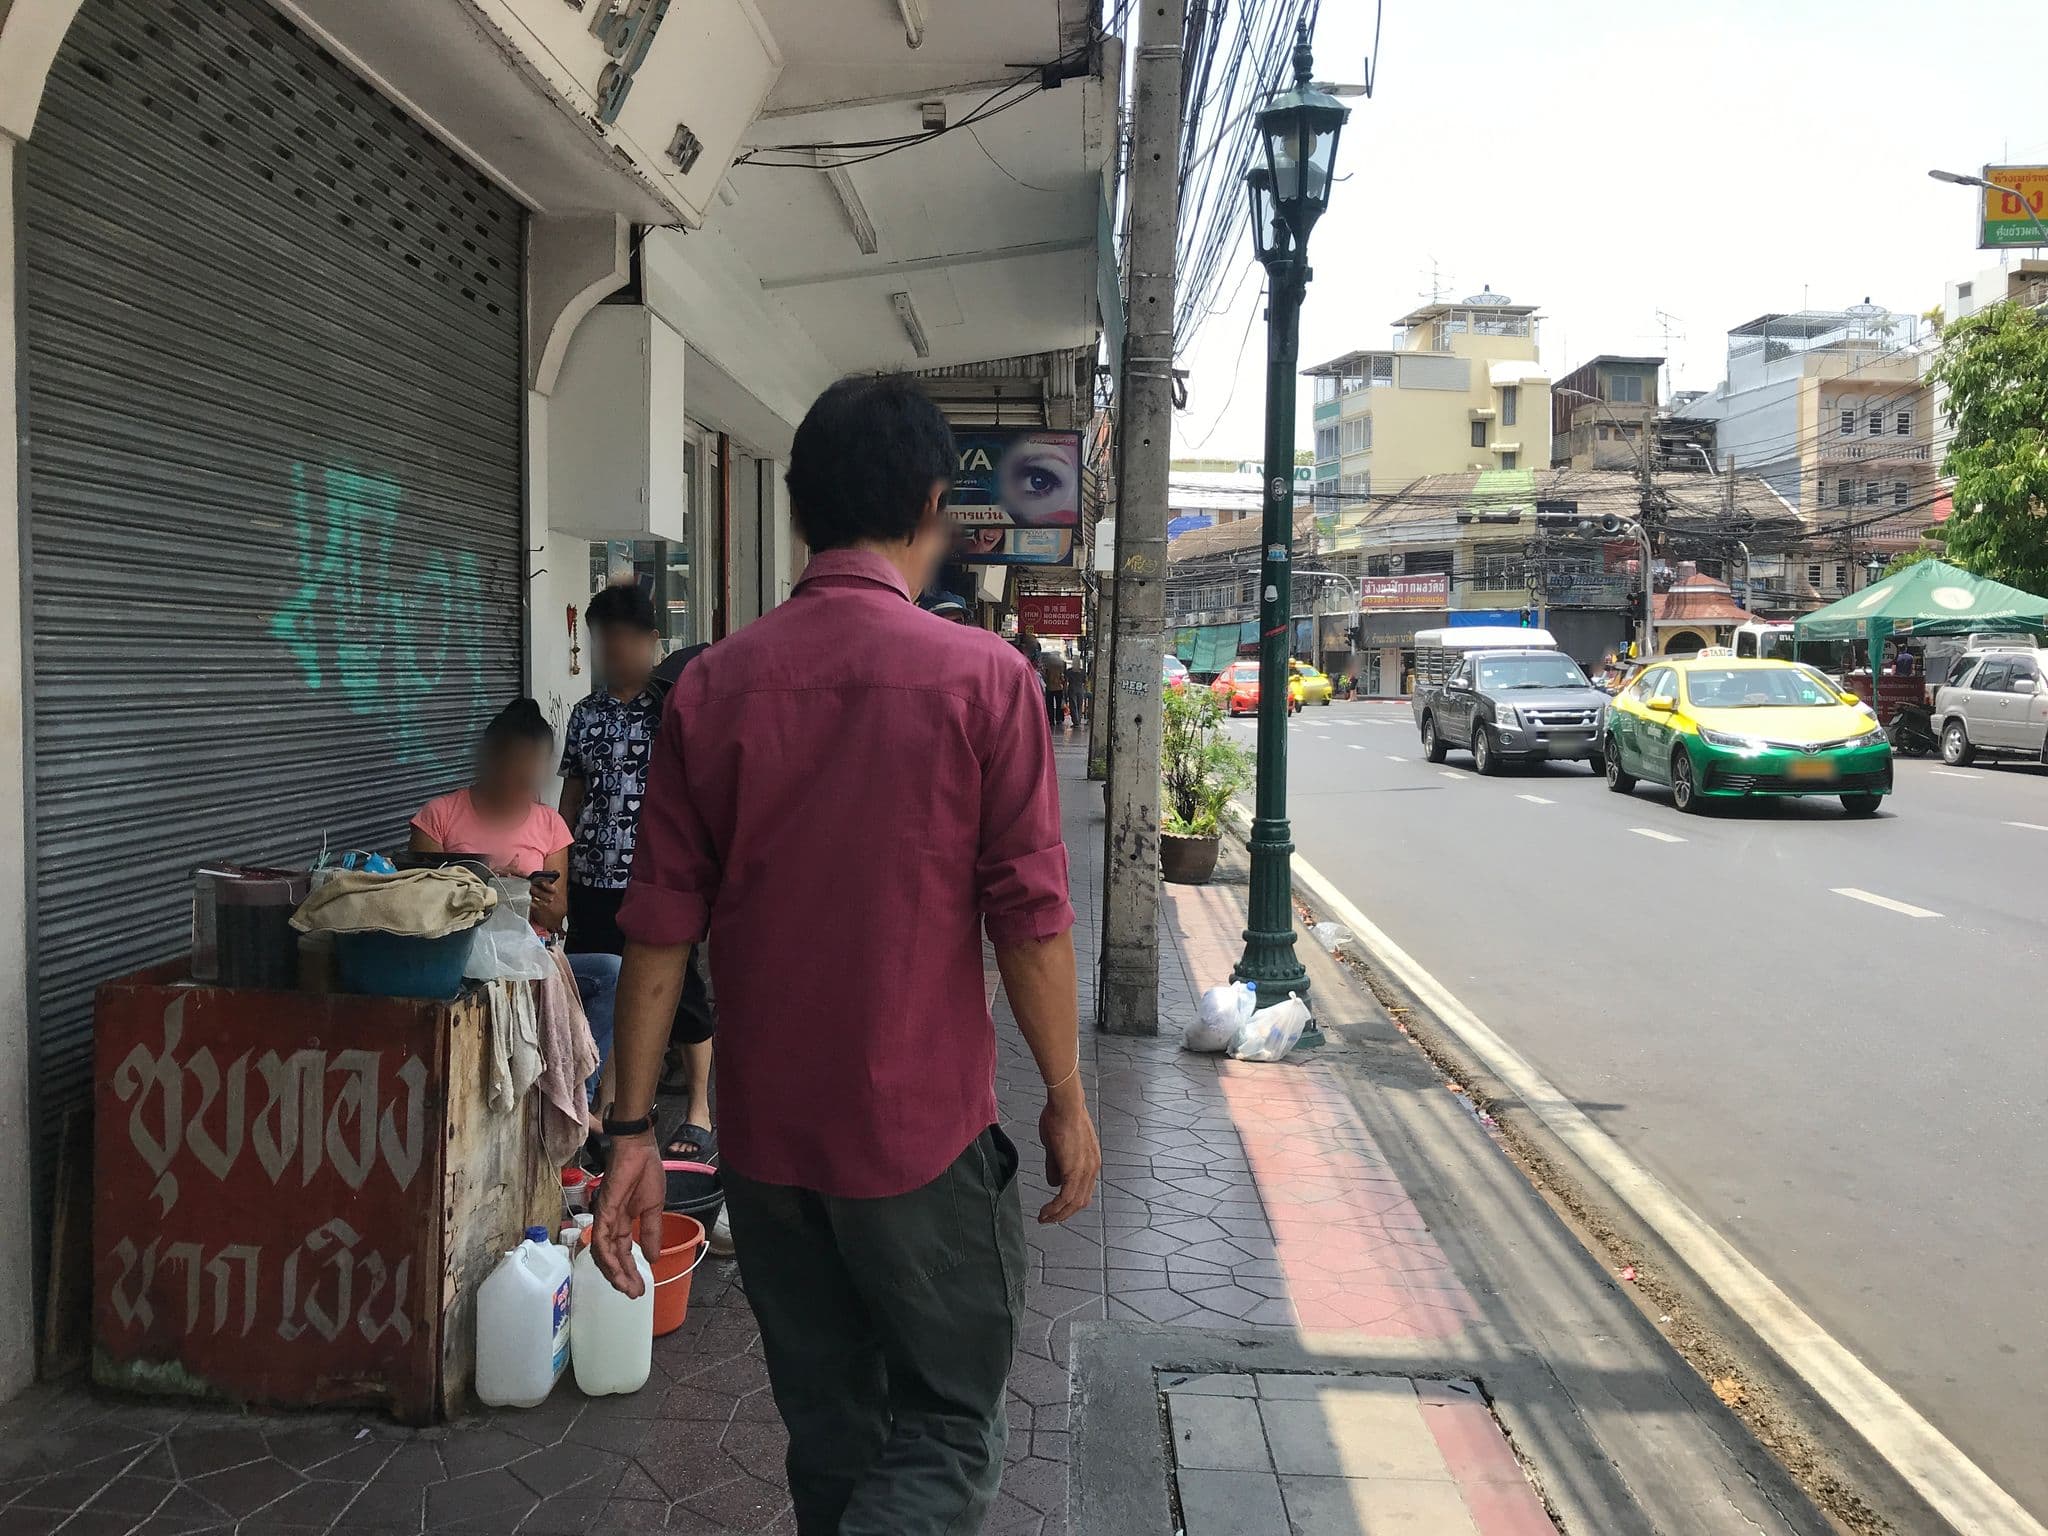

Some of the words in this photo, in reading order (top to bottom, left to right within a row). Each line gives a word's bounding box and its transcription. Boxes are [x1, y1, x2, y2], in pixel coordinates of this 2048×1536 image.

[1710, 649, 1726, 657] TAXI
[114, 990, 429, 1219] ชุบทอง
[107, 1233, 263, 1338] นาก
[278, 1217, 412, 1346] เงิน
